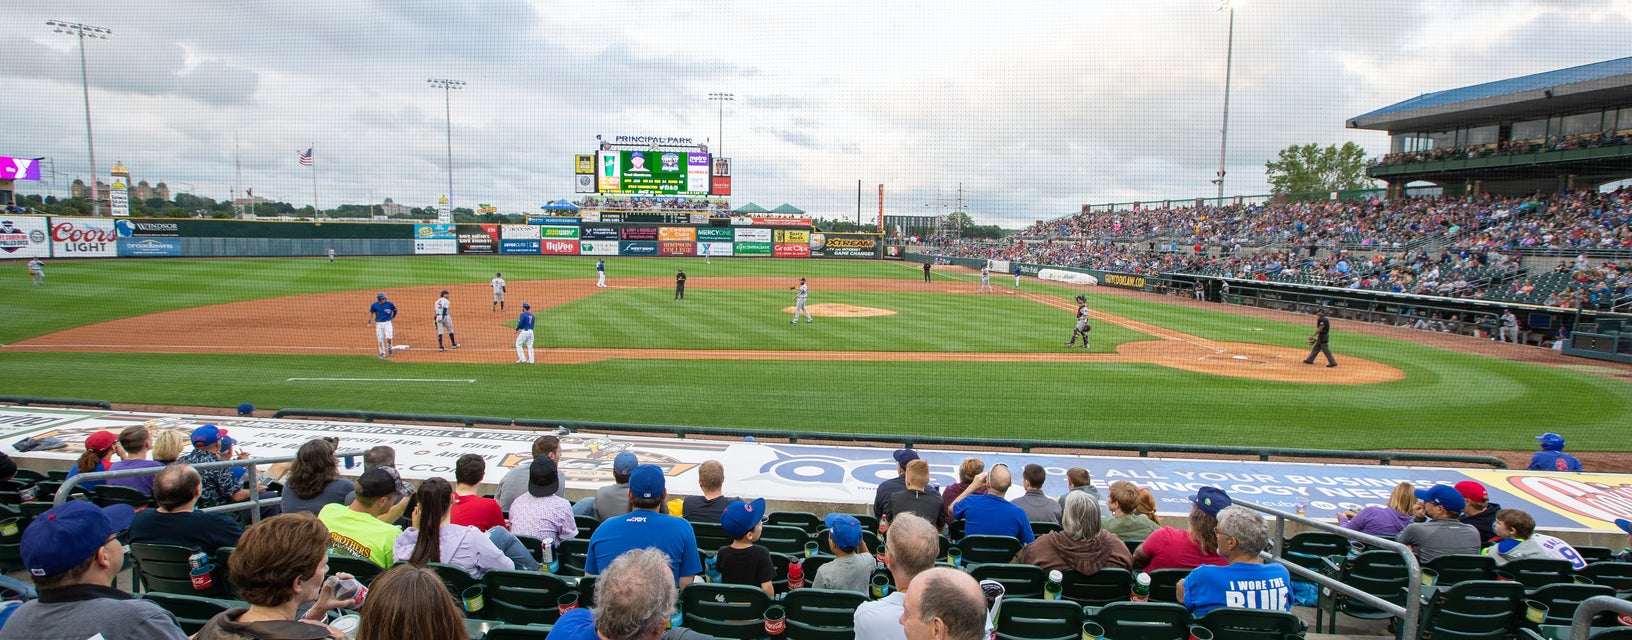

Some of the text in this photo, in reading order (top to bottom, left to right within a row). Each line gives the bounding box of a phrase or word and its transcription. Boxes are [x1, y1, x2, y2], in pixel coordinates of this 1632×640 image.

[616, 135, 665, 143] PRINCIPAL
[136, 222, 178, 231] WINDSOR
[52, 222, 118, 243] Coors
[65, 242, 106, 252] LIGHT
[127, 241, 174, 250] broadlawns
[826, 239, 875, 248] XTREAM
[793, 245, 810, 253] Clips
[328, 424, 404, 435] SPORTS
[404, 428, 453, 437] GRILL
[477, 432, 538, 442] PIZZER
[389, 438, 422, 446] Ave.
[460, 441, 502, 450] Clive
[435, 451, 498, 461] Anky
[1105, 468, 1169, 480] ALL
[1172, 470, 1282, 485] YOUR
[1557, 545, 1586, 569] 9
[1229, 577, 1285, 591] I WORE THE
[1225, 586, 1290, 611] BLUE
